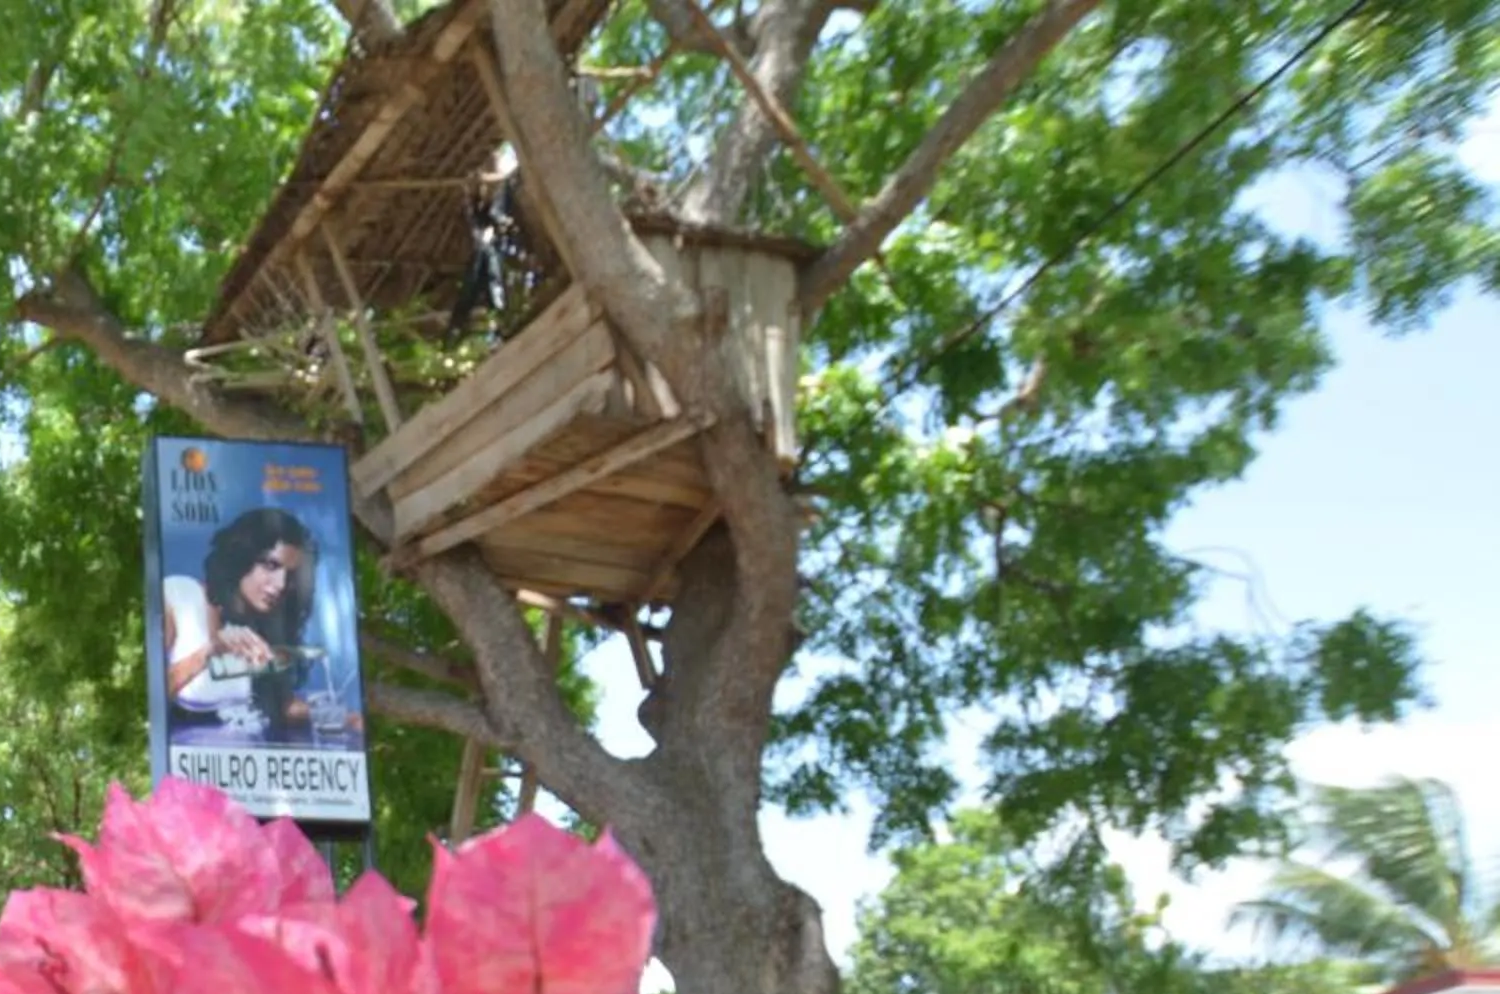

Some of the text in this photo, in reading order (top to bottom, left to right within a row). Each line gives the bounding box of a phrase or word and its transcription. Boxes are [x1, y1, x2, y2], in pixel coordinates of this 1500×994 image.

[171, 468, 217, 493] LION
[171, 501, 220, 523] SODA
[179, 753, 360, 793] SIHILRO REGENCY
